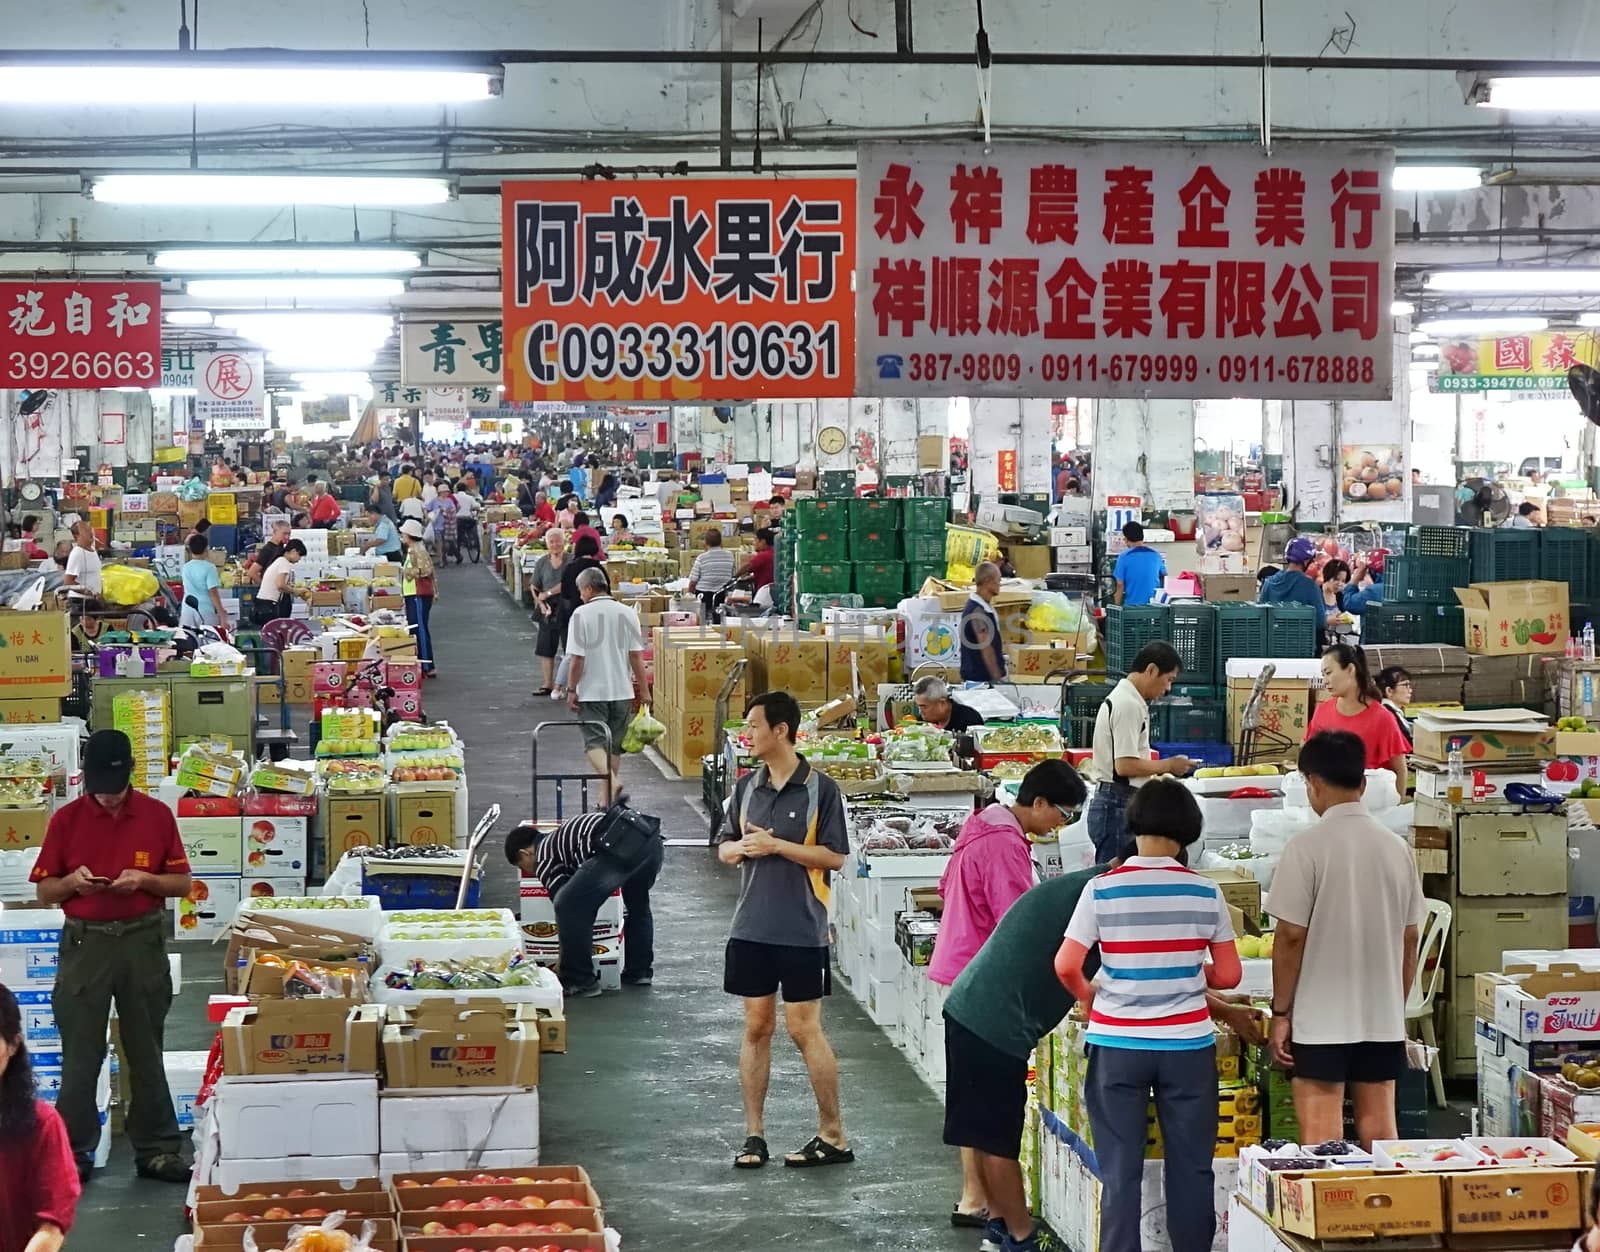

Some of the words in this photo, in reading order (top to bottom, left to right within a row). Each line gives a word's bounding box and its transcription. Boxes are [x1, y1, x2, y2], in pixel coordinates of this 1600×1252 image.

[515, 196, 842, 306] 阿成水果行
[873, 256, 1379, 341] 祥順源企業有限公司
[8, 352, 154, 379] 3926663
[561, 322, 841, 382] 0933319631
[909, 353, 1021, 381] 387-9809
[1041, 354, 1197, 382] 0911-679999
[1218, 355, 1374, 383] 0911-678888
[213, 358, 247, 394] 展
[1552, 1008, 1596, 1029] Fruit
[1323, 1190, 1355, 1202] FRUIT
